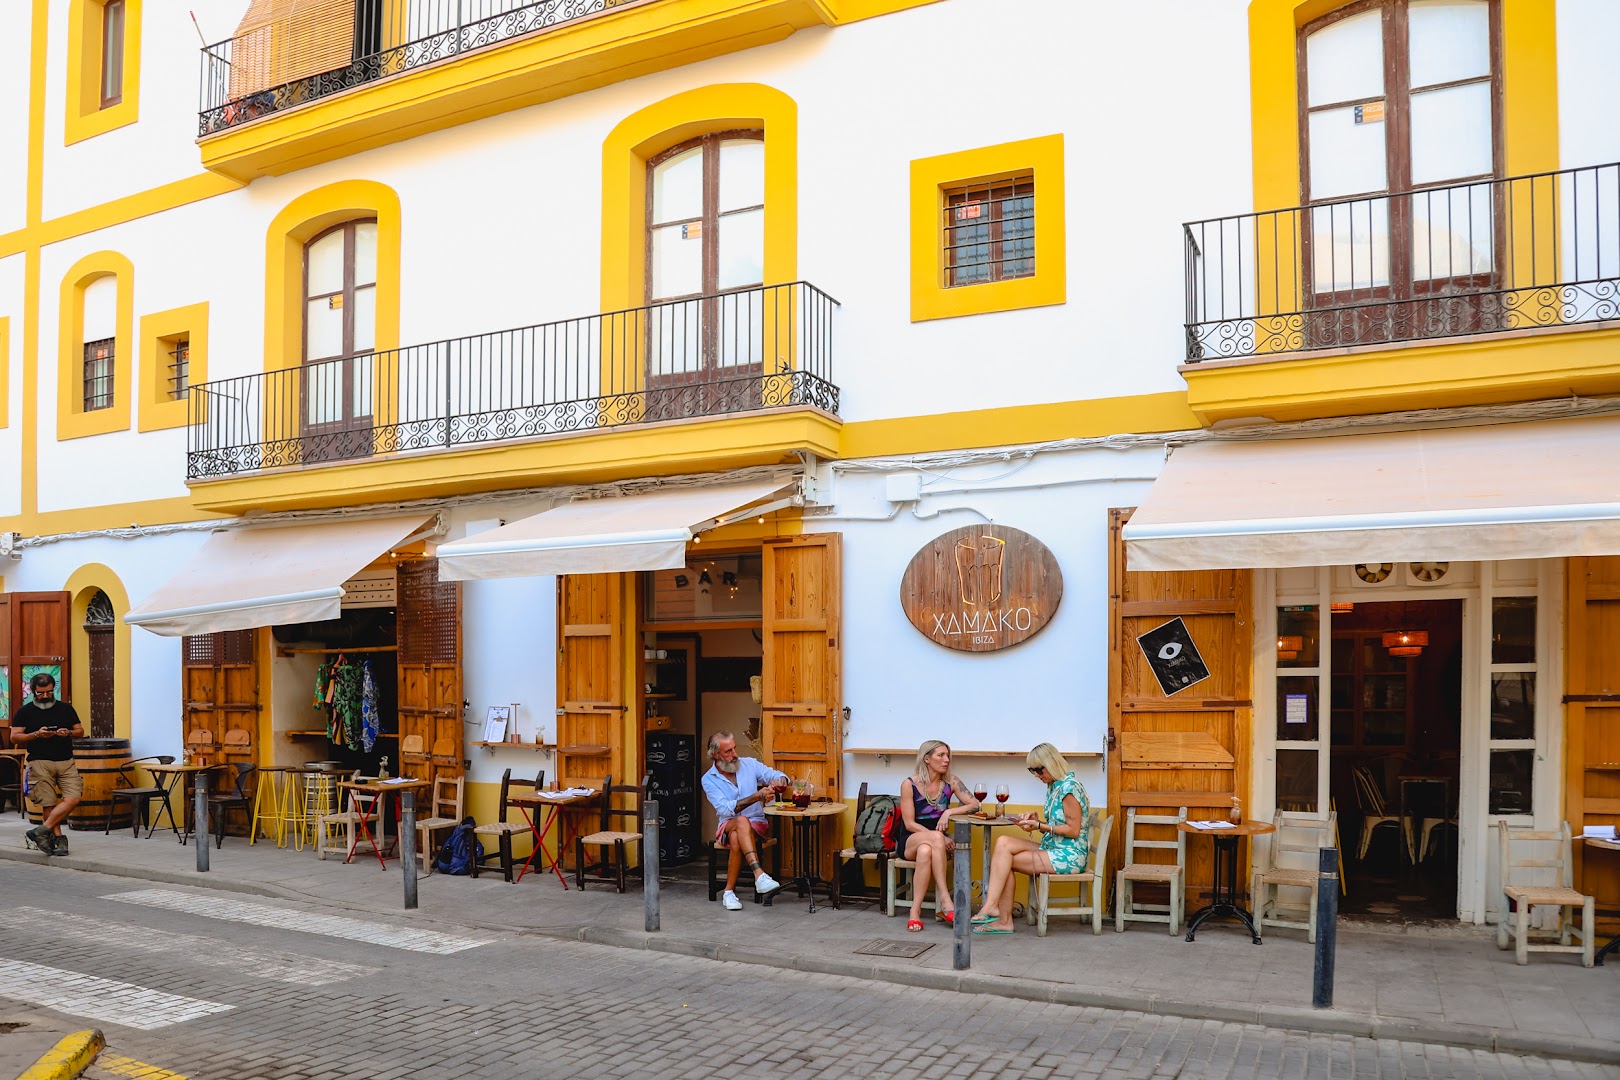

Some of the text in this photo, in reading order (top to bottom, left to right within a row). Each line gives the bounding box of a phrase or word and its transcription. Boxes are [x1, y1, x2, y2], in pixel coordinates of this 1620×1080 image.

[675, 571, 738, 588] BAR
[933, 607, 1031, 635] XAMAKO
[972, 636, 995, 644] IBIZA
